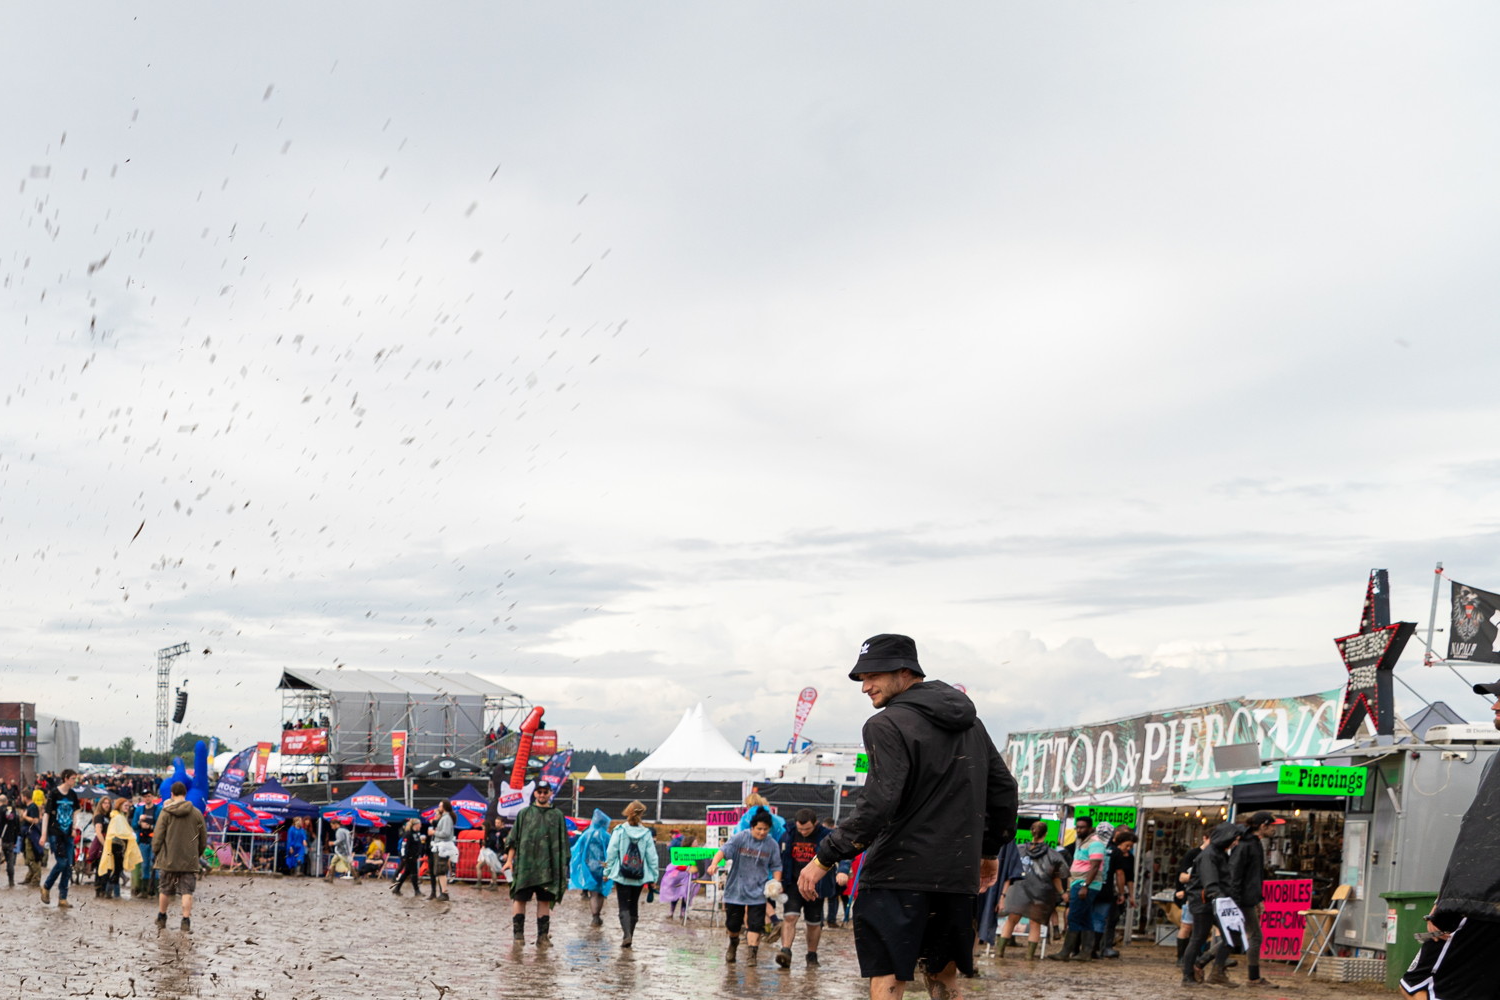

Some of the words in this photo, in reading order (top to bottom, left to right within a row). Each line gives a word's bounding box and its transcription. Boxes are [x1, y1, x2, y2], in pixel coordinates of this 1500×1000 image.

[1007, 730, 1118, 793] TATTOO
[1121, 739, 1142, 788] &
[1139, 700, 1337, 786] PIERCING
[218, 782, 242, 794] ROCK
[1298, 768, 1363, 794] Piercings
[502, 793, 520, 803] ROCK
[502, 798, 524, 808] ANTENNE
[707, 812, 739, 824] TATTOO
[1088, 808, 1135, 826] Piercings
[1264, 883, 1311, 902] MOBILES
[1263, 936, 1300, 956] STUDIO
